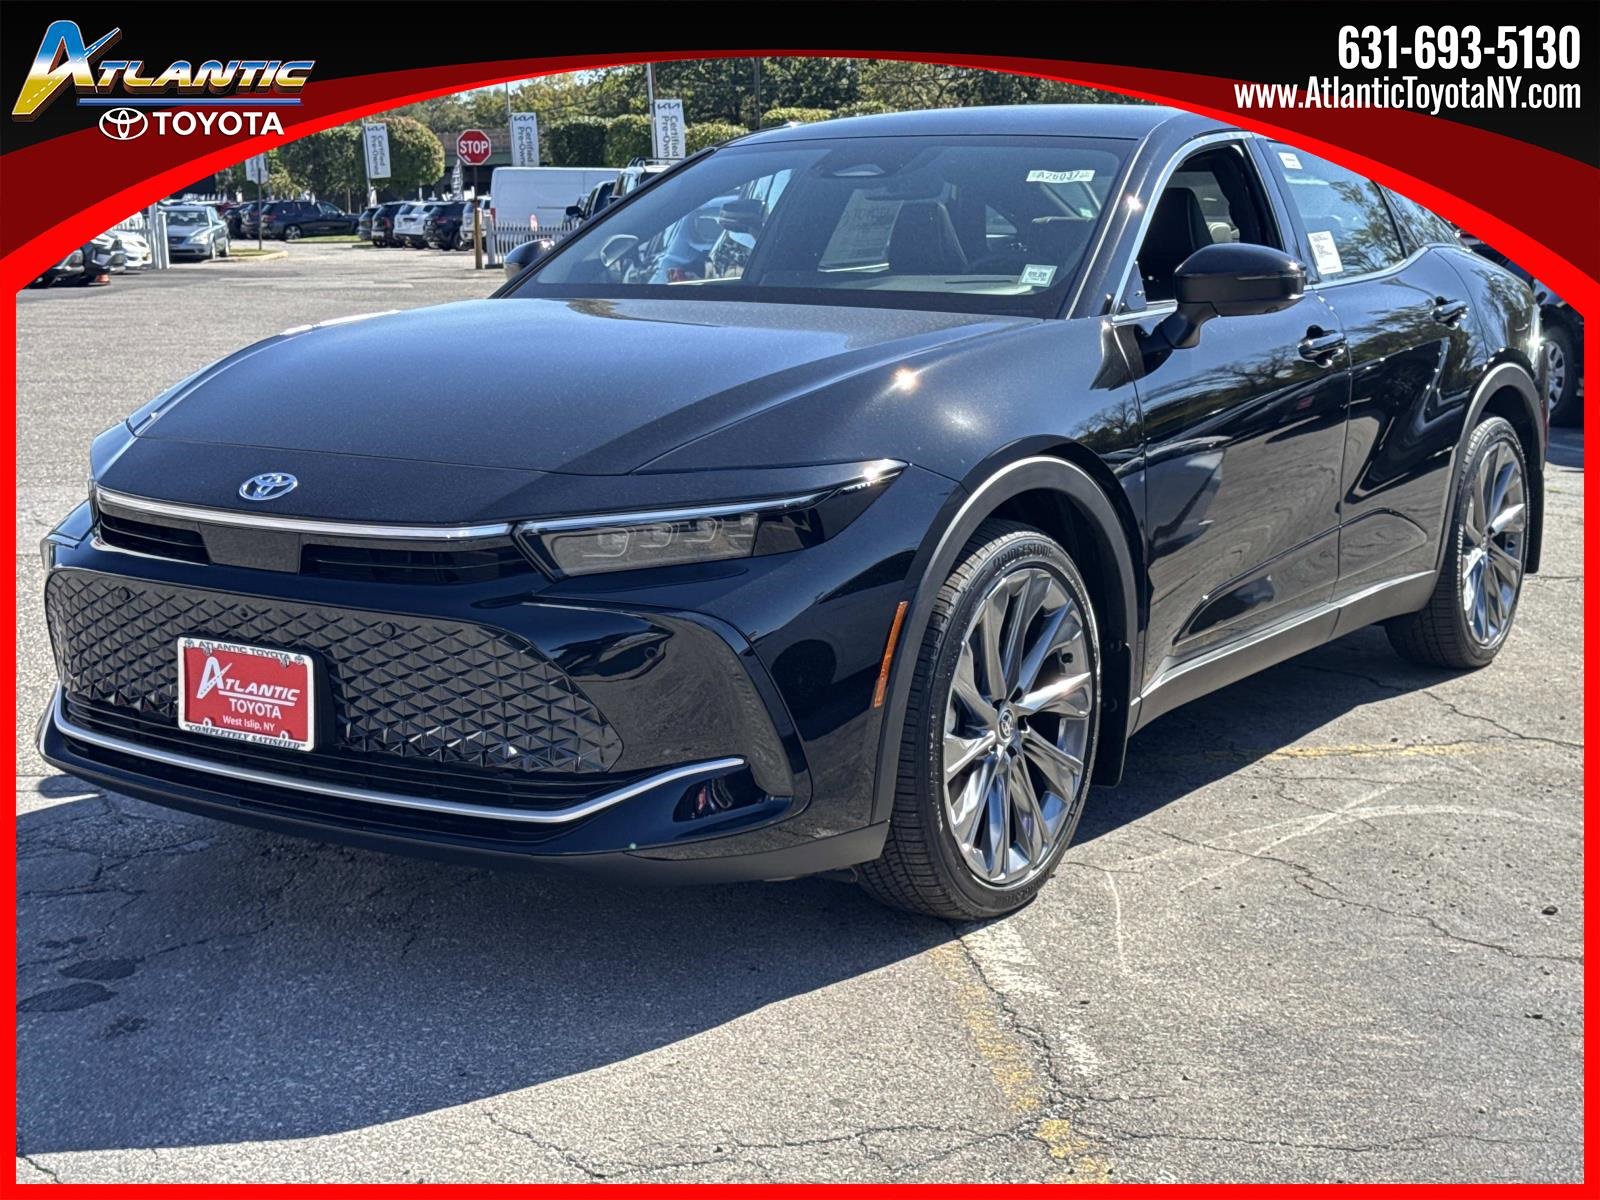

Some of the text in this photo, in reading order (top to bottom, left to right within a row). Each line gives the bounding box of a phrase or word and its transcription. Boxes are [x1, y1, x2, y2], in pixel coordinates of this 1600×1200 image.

[459, 140, 489, 154] STOP
[525, 126, 534, 162] Certified
[670, 115, 679, 157] Certified
[199, 641, 290, 663] ATLANTIC TOYOTA
[196, 656, 301, 701] ATLANTIC
[229, 698, 281, 719] TOYOTA
[223, 715, 275, 731] West Islip, NY
